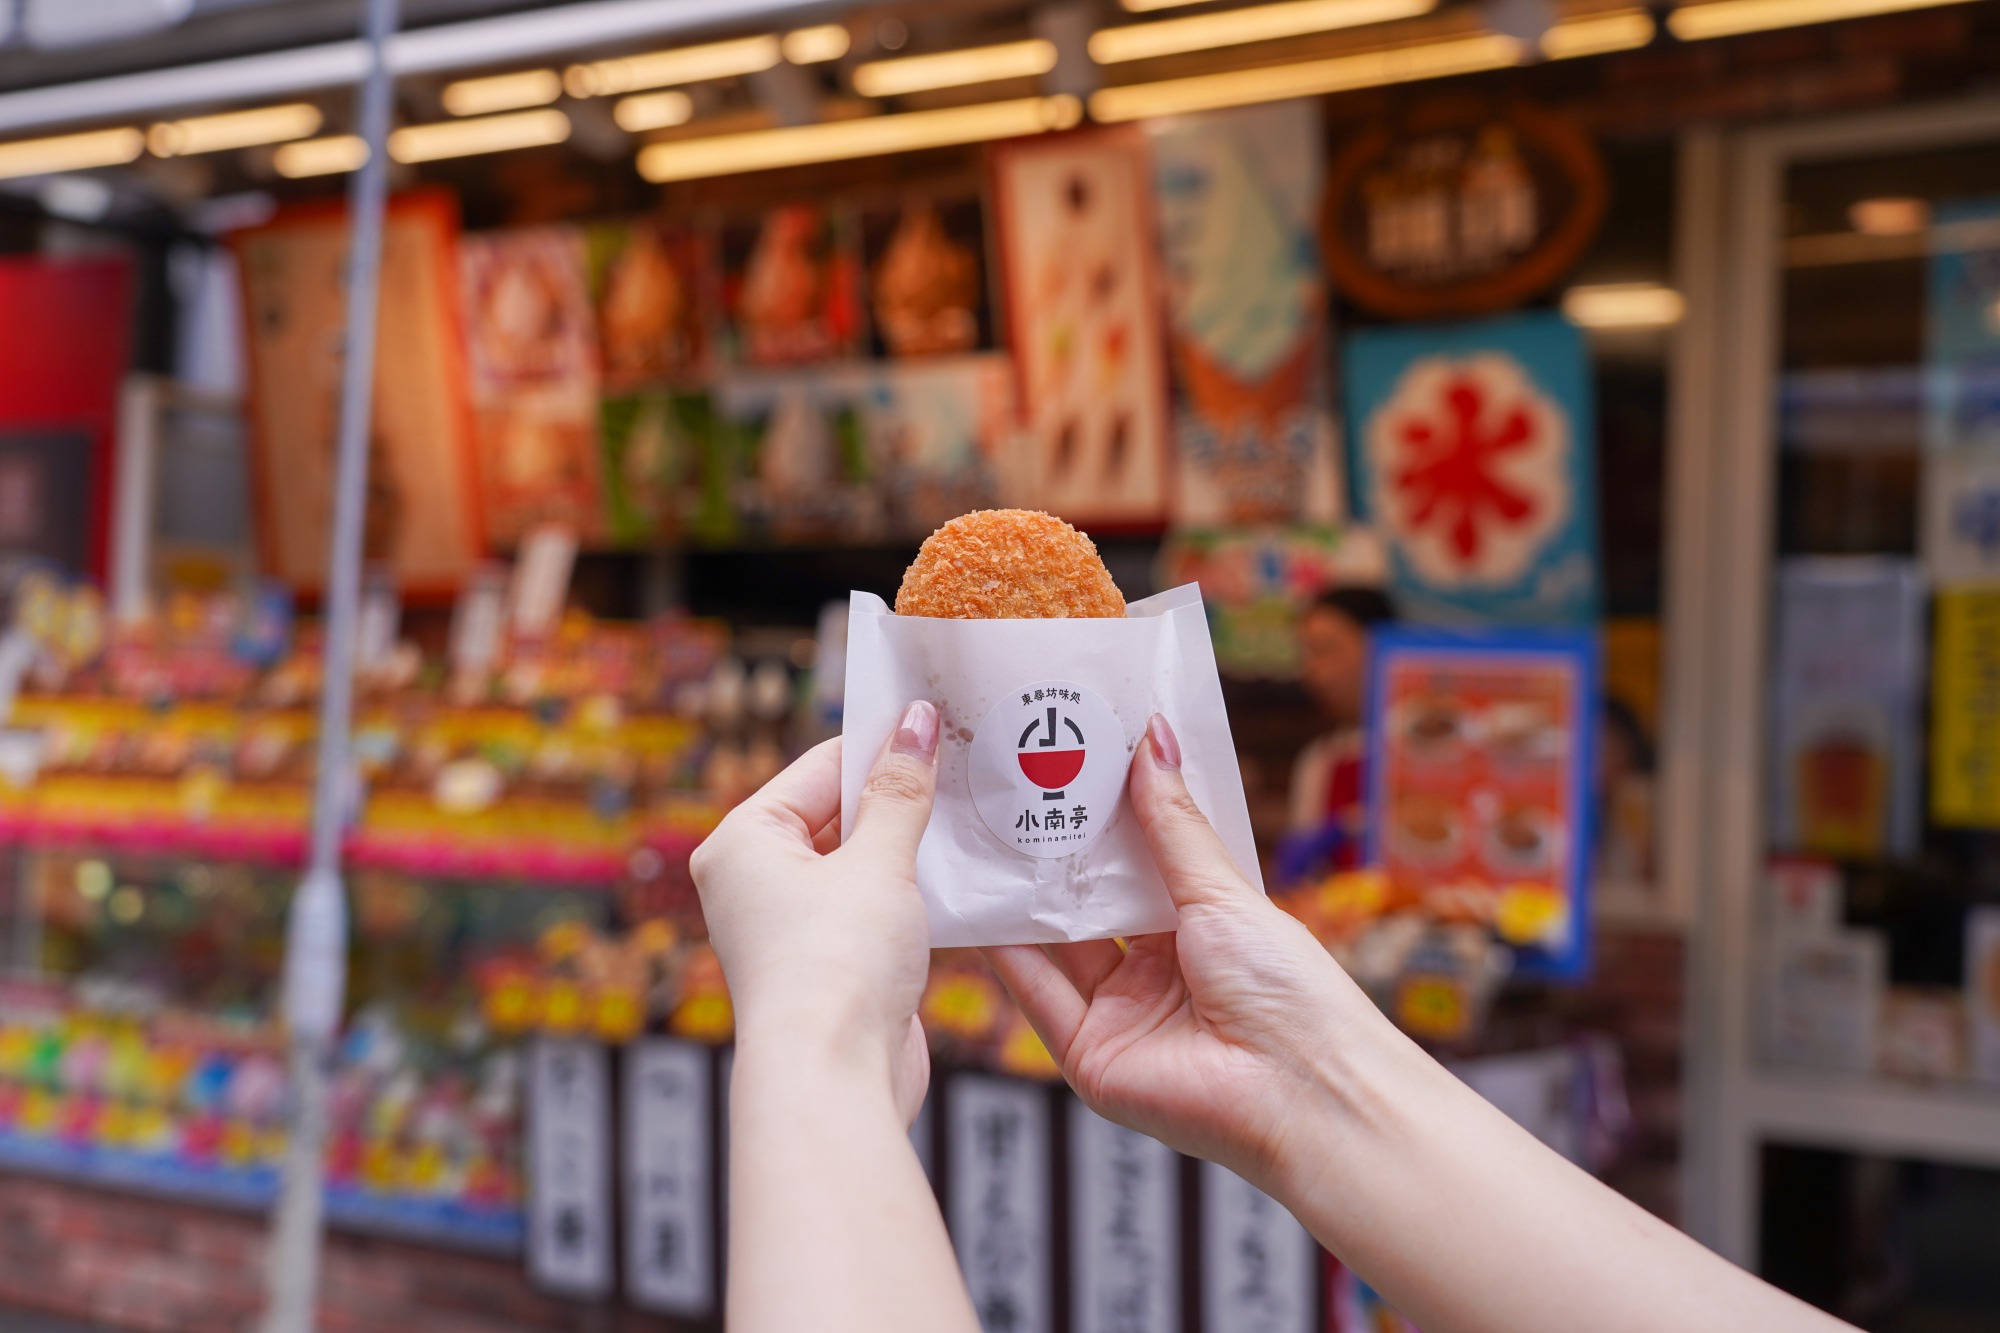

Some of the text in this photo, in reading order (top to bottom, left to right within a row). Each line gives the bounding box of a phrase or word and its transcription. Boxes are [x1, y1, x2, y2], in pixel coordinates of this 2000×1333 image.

[1387, 372, 1542, 576] 氷
[1021, 687, 1081, 707] 東尋坊味処
[1015, 804, 1088, 832] 小南亭
[1017, 832, 1086, 844] kominamitei
